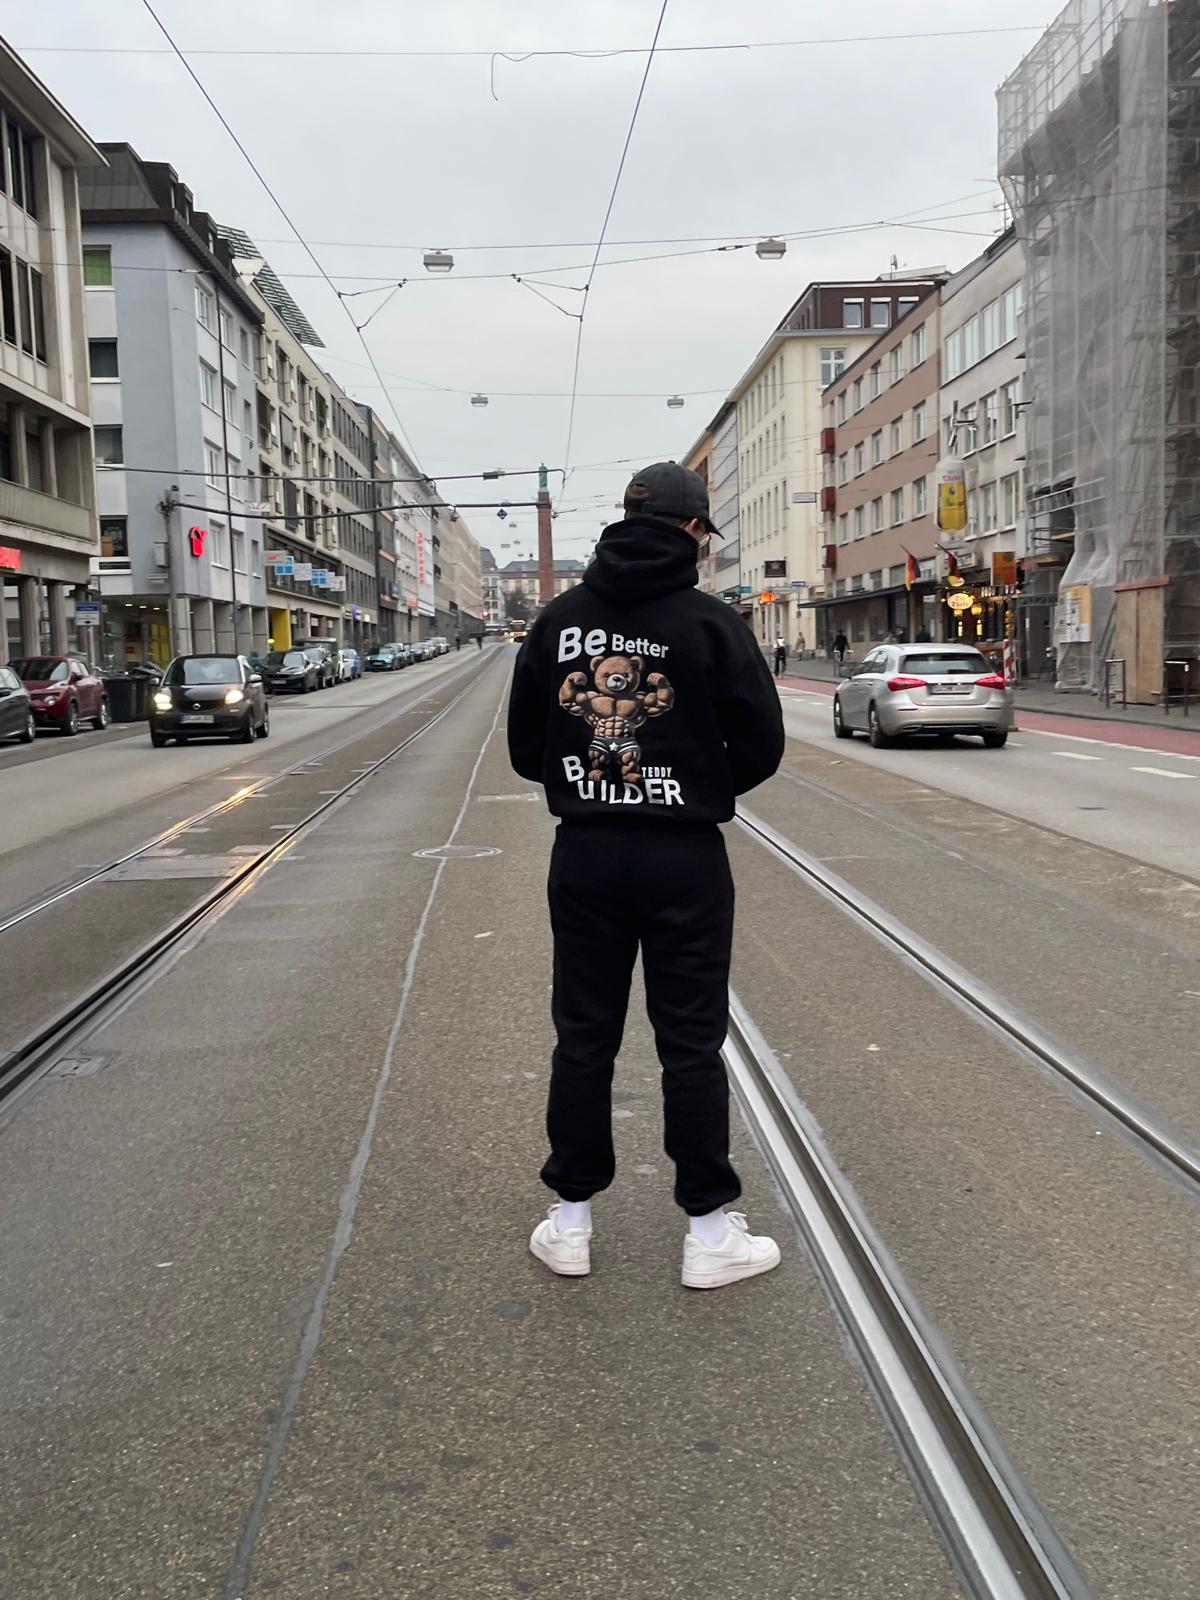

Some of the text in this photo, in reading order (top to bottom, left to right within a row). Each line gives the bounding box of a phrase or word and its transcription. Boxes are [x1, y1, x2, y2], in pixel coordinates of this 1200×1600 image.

[557, 626, 669, 663] Be Better
[641, 766, 673, 778] TEDDY
